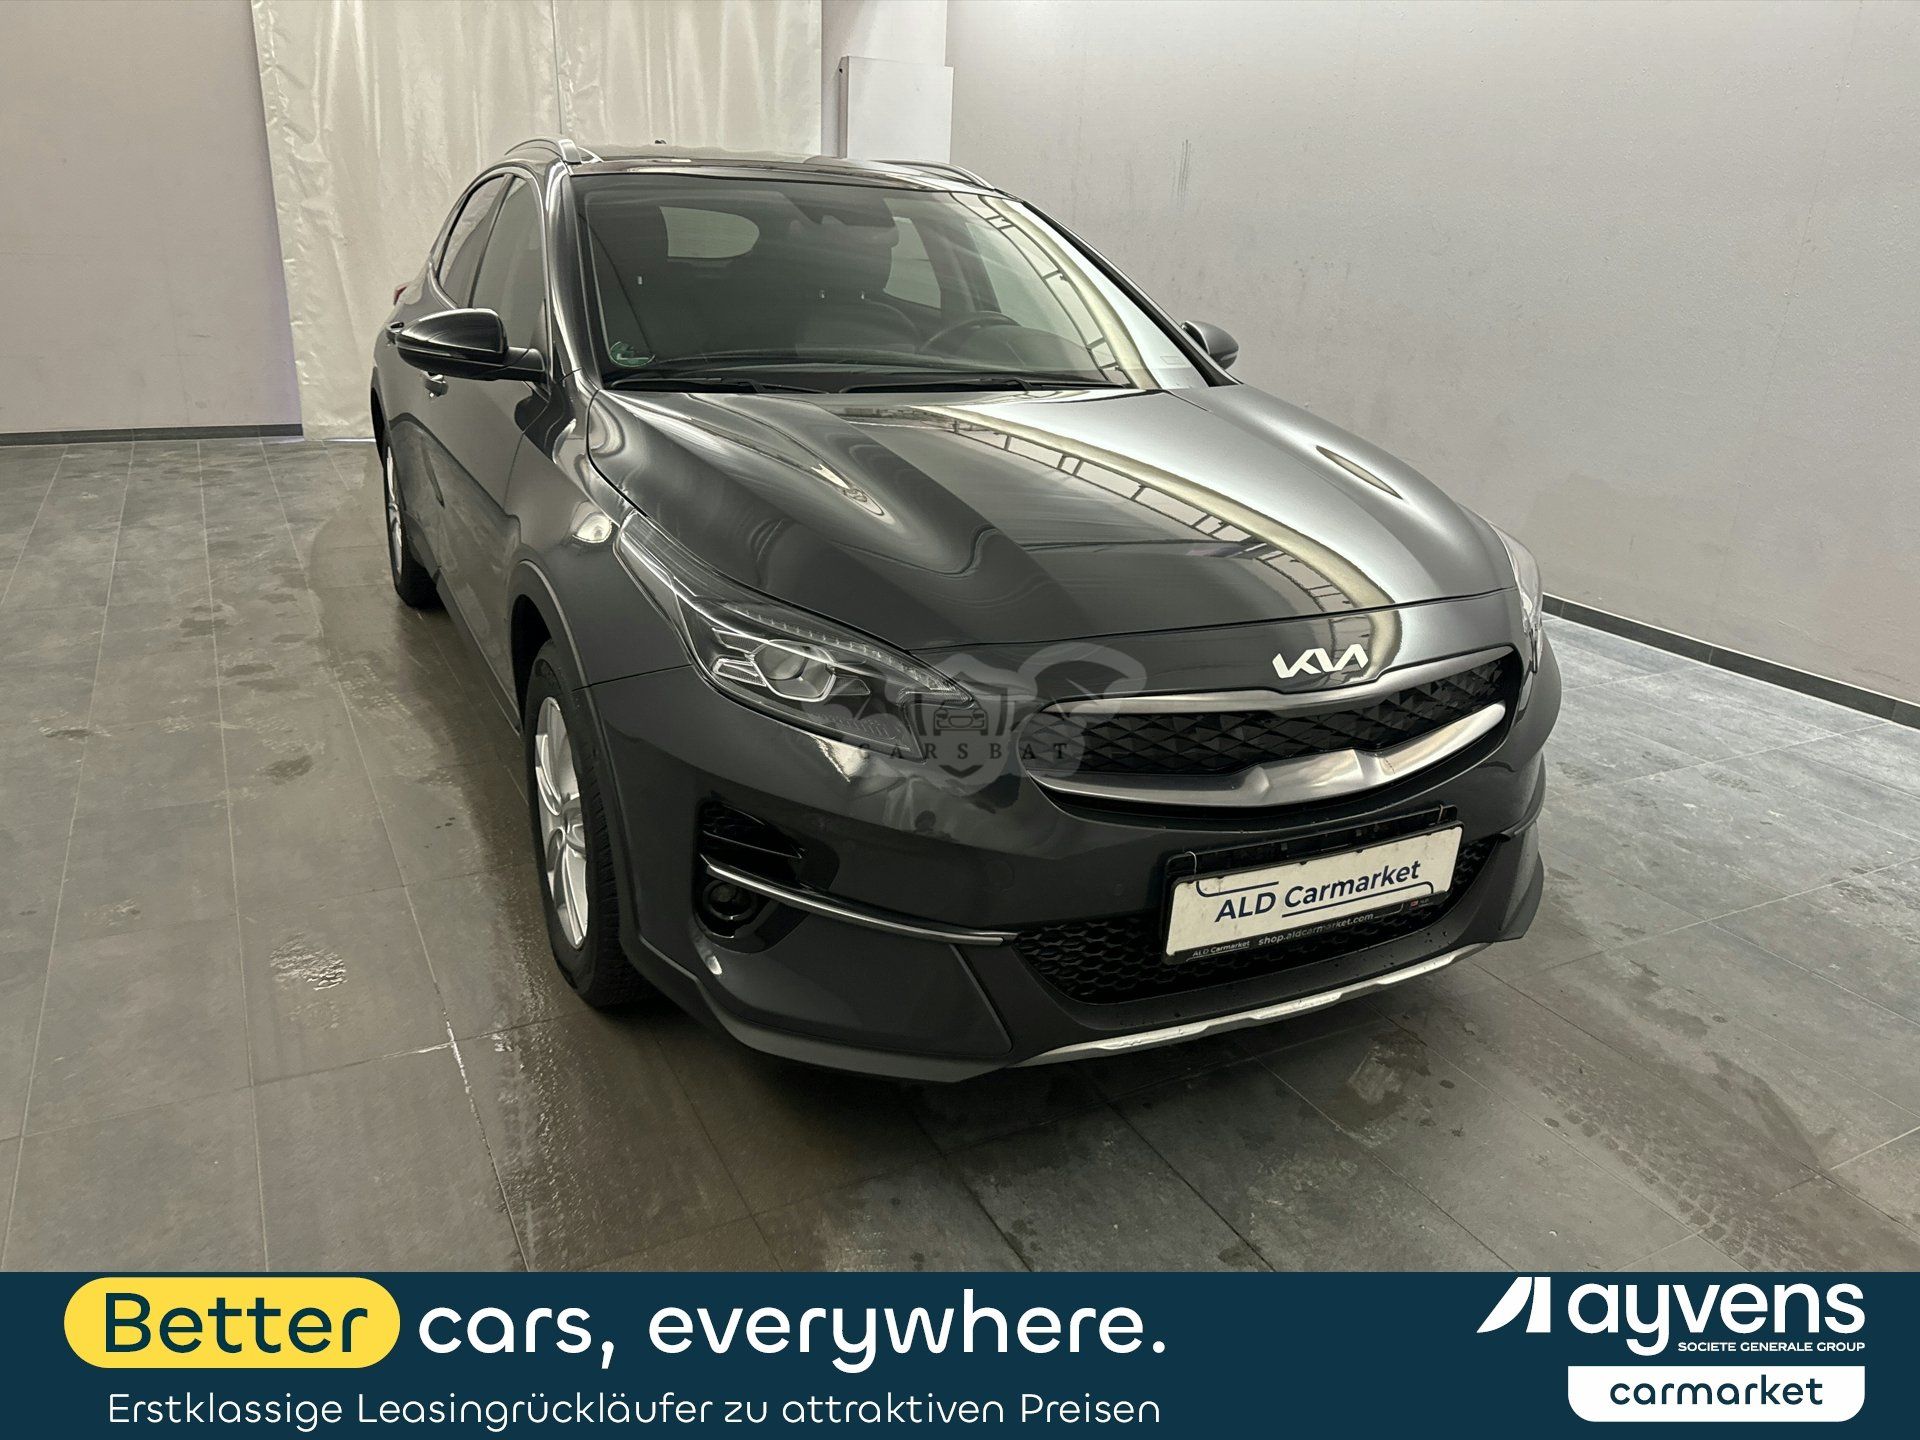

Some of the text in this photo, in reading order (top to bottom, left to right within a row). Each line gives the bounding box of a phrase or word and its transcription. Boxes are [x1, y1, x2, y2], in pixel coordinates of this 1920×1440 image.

[1272, 643, 1369, 679] KIA
[1215, 860, 1421, 923] ALD Carmarket
[1258, 913, 1375, 947] shop.aldcarmarket.com
